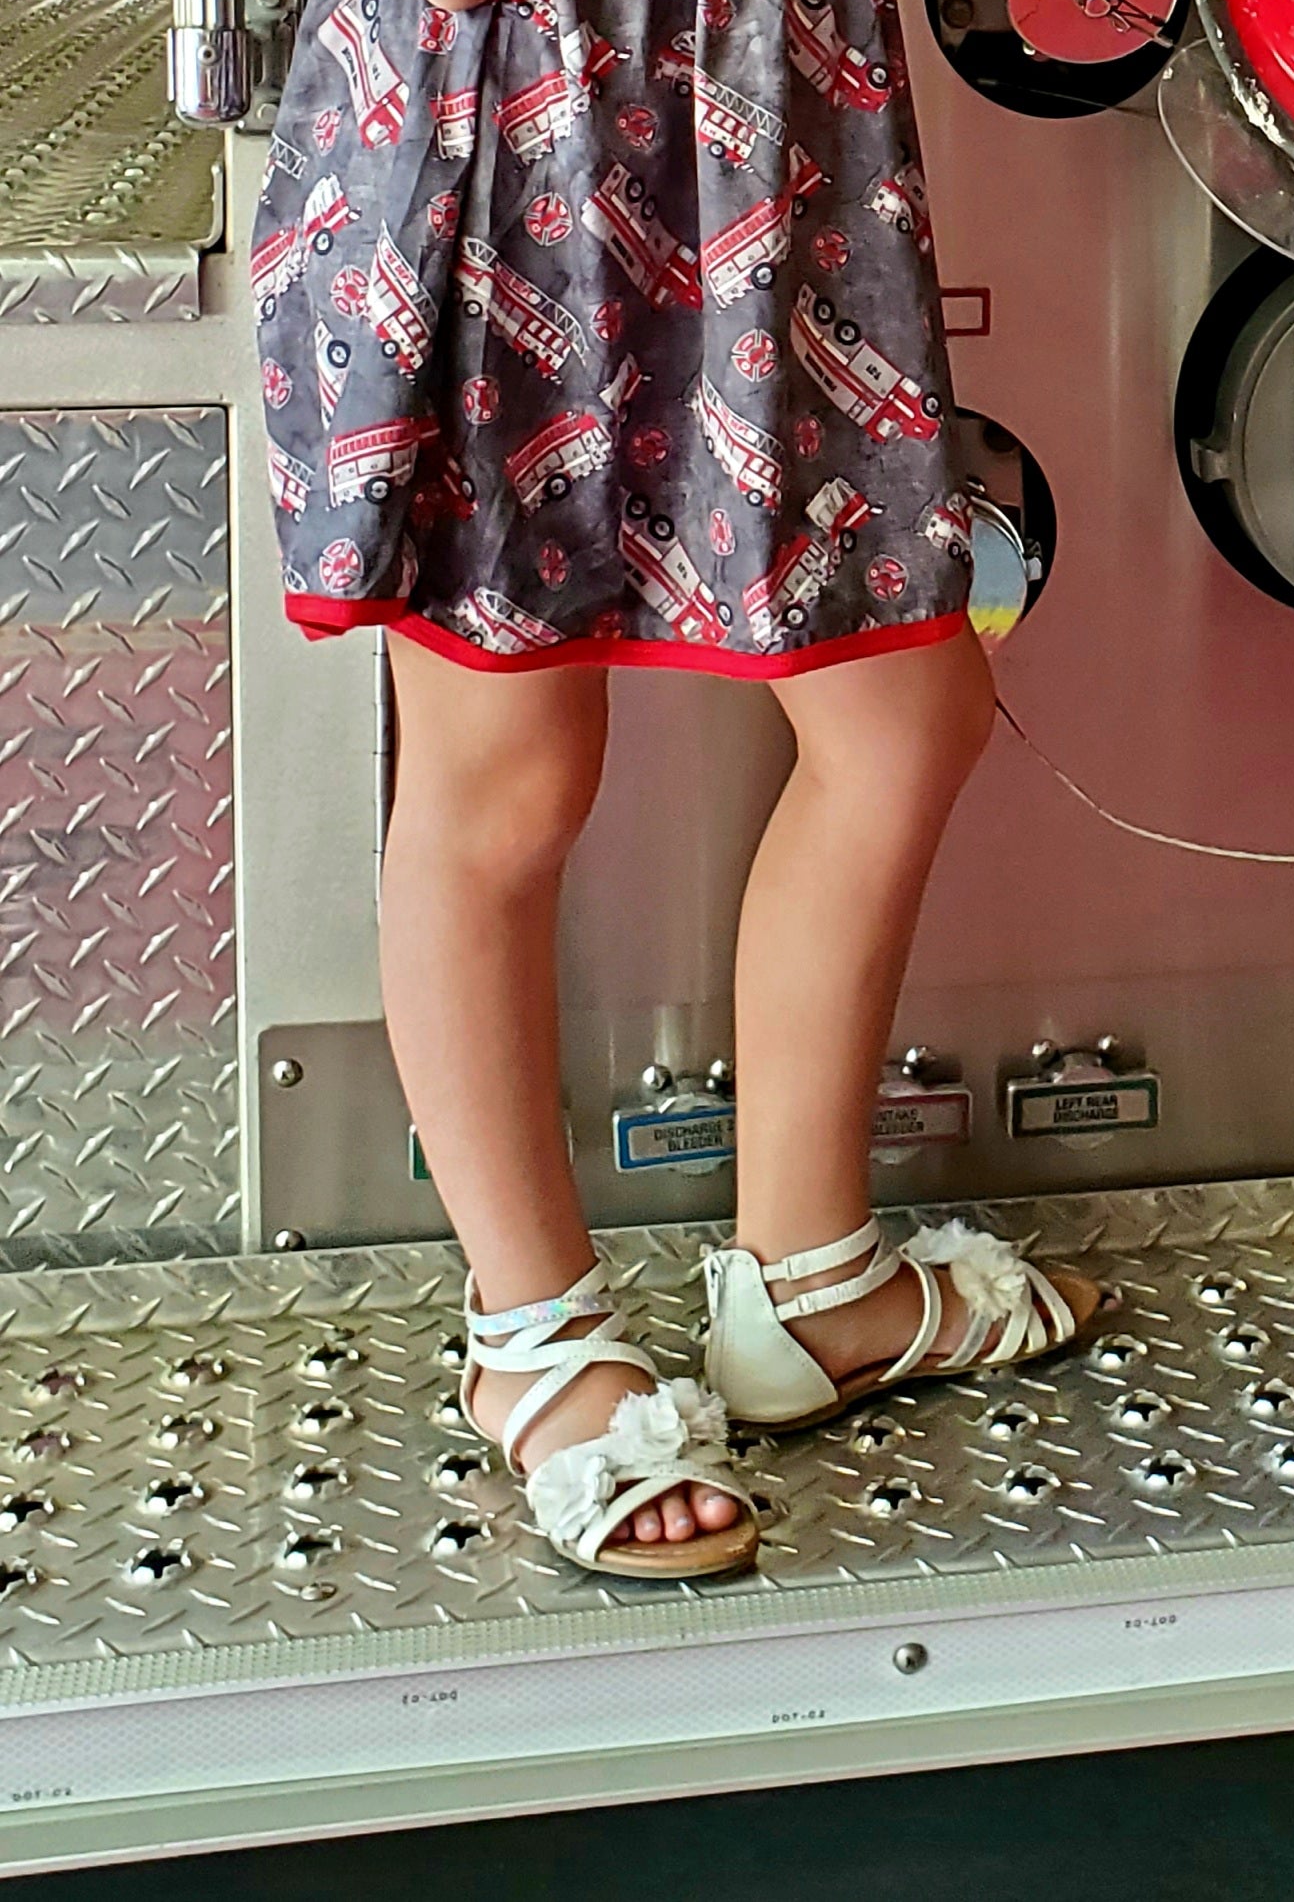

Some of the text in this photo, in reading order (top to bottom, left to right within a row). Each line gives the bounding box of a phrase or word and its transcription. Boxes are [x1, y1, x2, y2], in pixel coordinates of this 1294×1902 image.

[1056, 1094, 1118, 1110] LEFT REAR
[1053, 1106, 1118, 1123] DISCHARGE
[654, 1120, 722, 1141] DISCHARGE
[668, 1135, 723, 1152] BLEEDER
